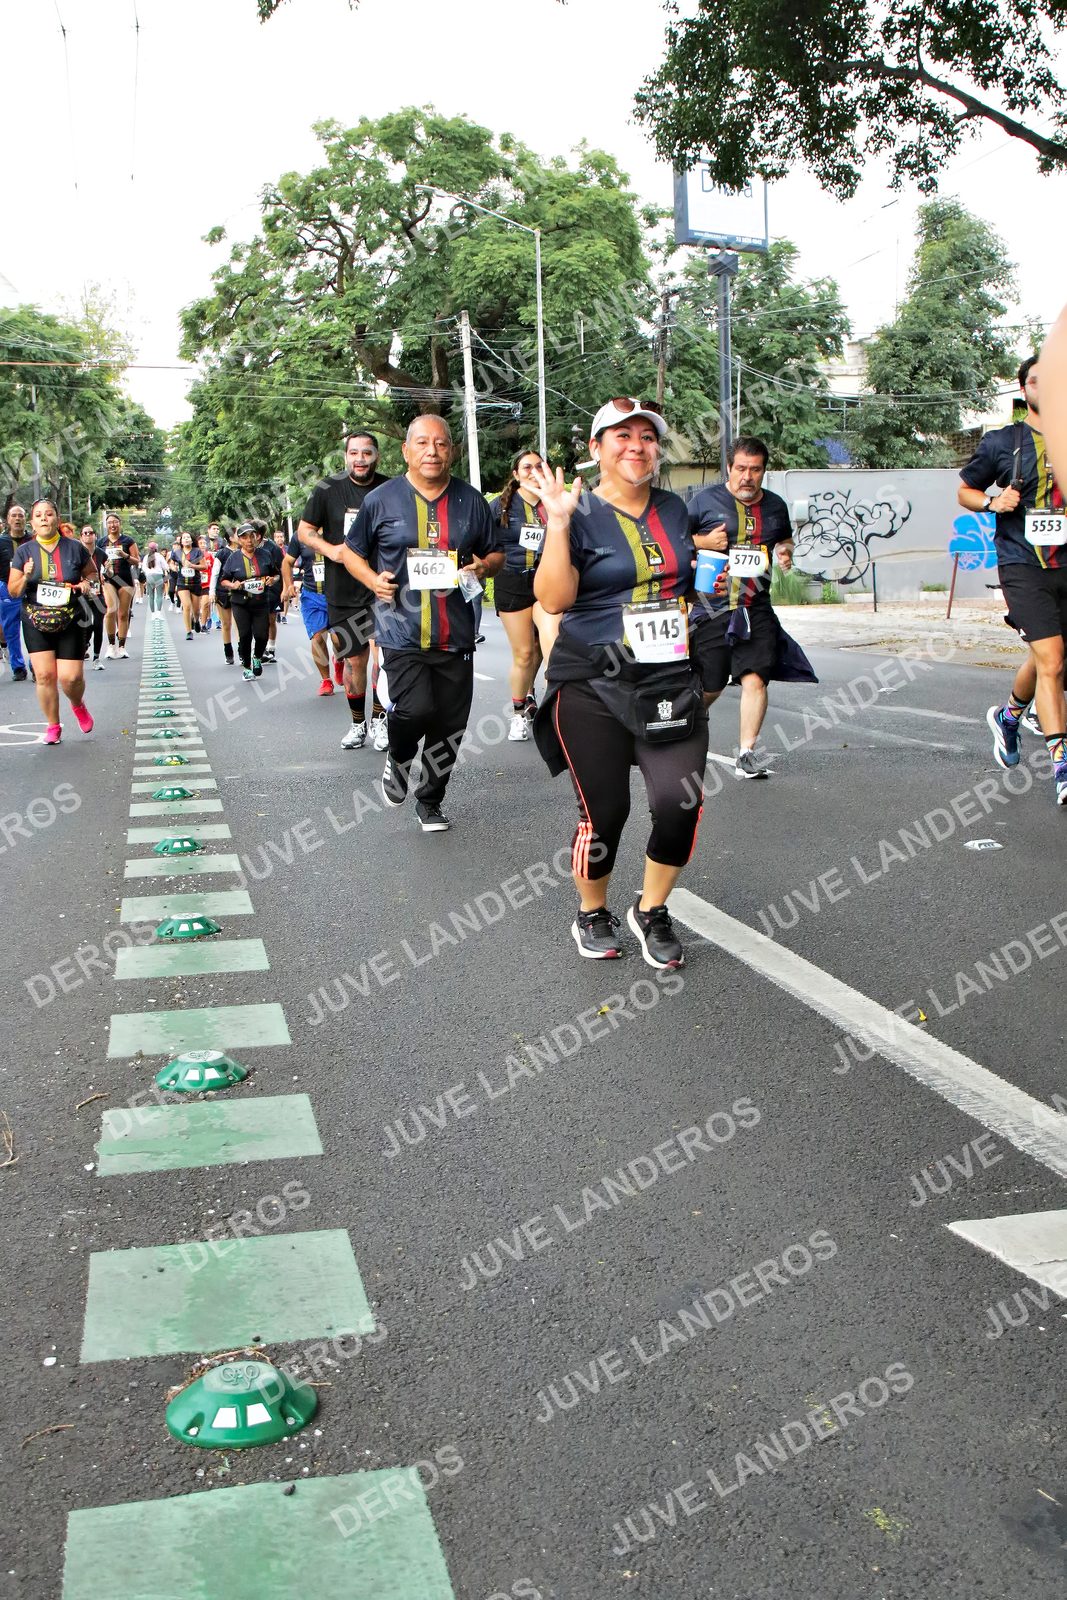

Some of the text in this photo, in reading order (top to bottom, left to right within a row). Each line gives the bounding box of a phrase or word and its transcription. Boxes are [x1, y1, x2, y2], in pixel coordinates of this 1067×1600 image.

[809, 489, 852, 506] TOY
[1031, 519, 1062, 533] 5553
[734, 554, 761, 566] 5770
[413, 561, 446, 576] 4662
[41, 587, 63, 599] 5507
[635, 618, 681, 642] 1145
